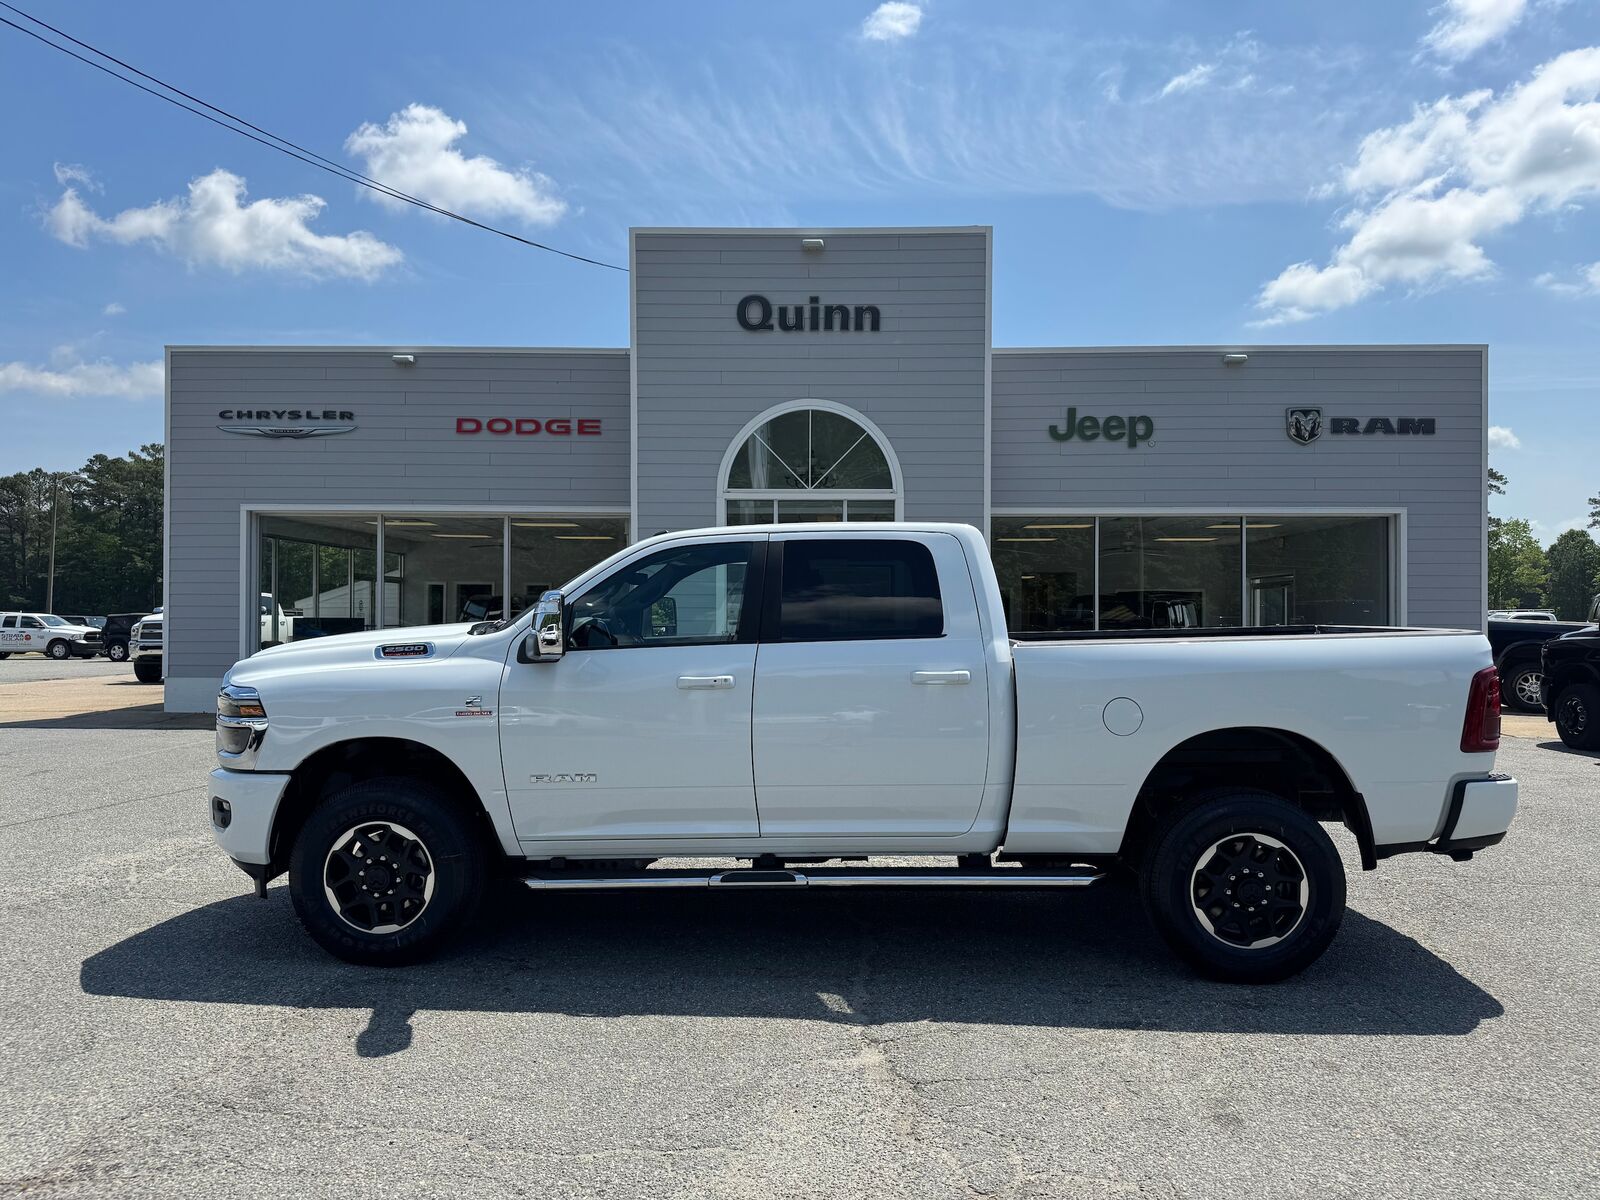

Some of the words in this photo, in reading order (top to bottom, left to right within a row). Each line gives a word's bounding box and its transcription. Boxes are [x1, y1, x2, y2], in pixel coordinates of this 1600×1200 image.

[736, 294, 881, 332] Quinn
[218, 410, 355, 421] CHRYSLER
[456, 418, 603, 436] DODGE
[1048, 407, 1154, 448] Jeep
[1330, 418, 1436, 435] RAM
[384, 645, 425, 653] 2500
[529, 773, 597, 784] RAM
